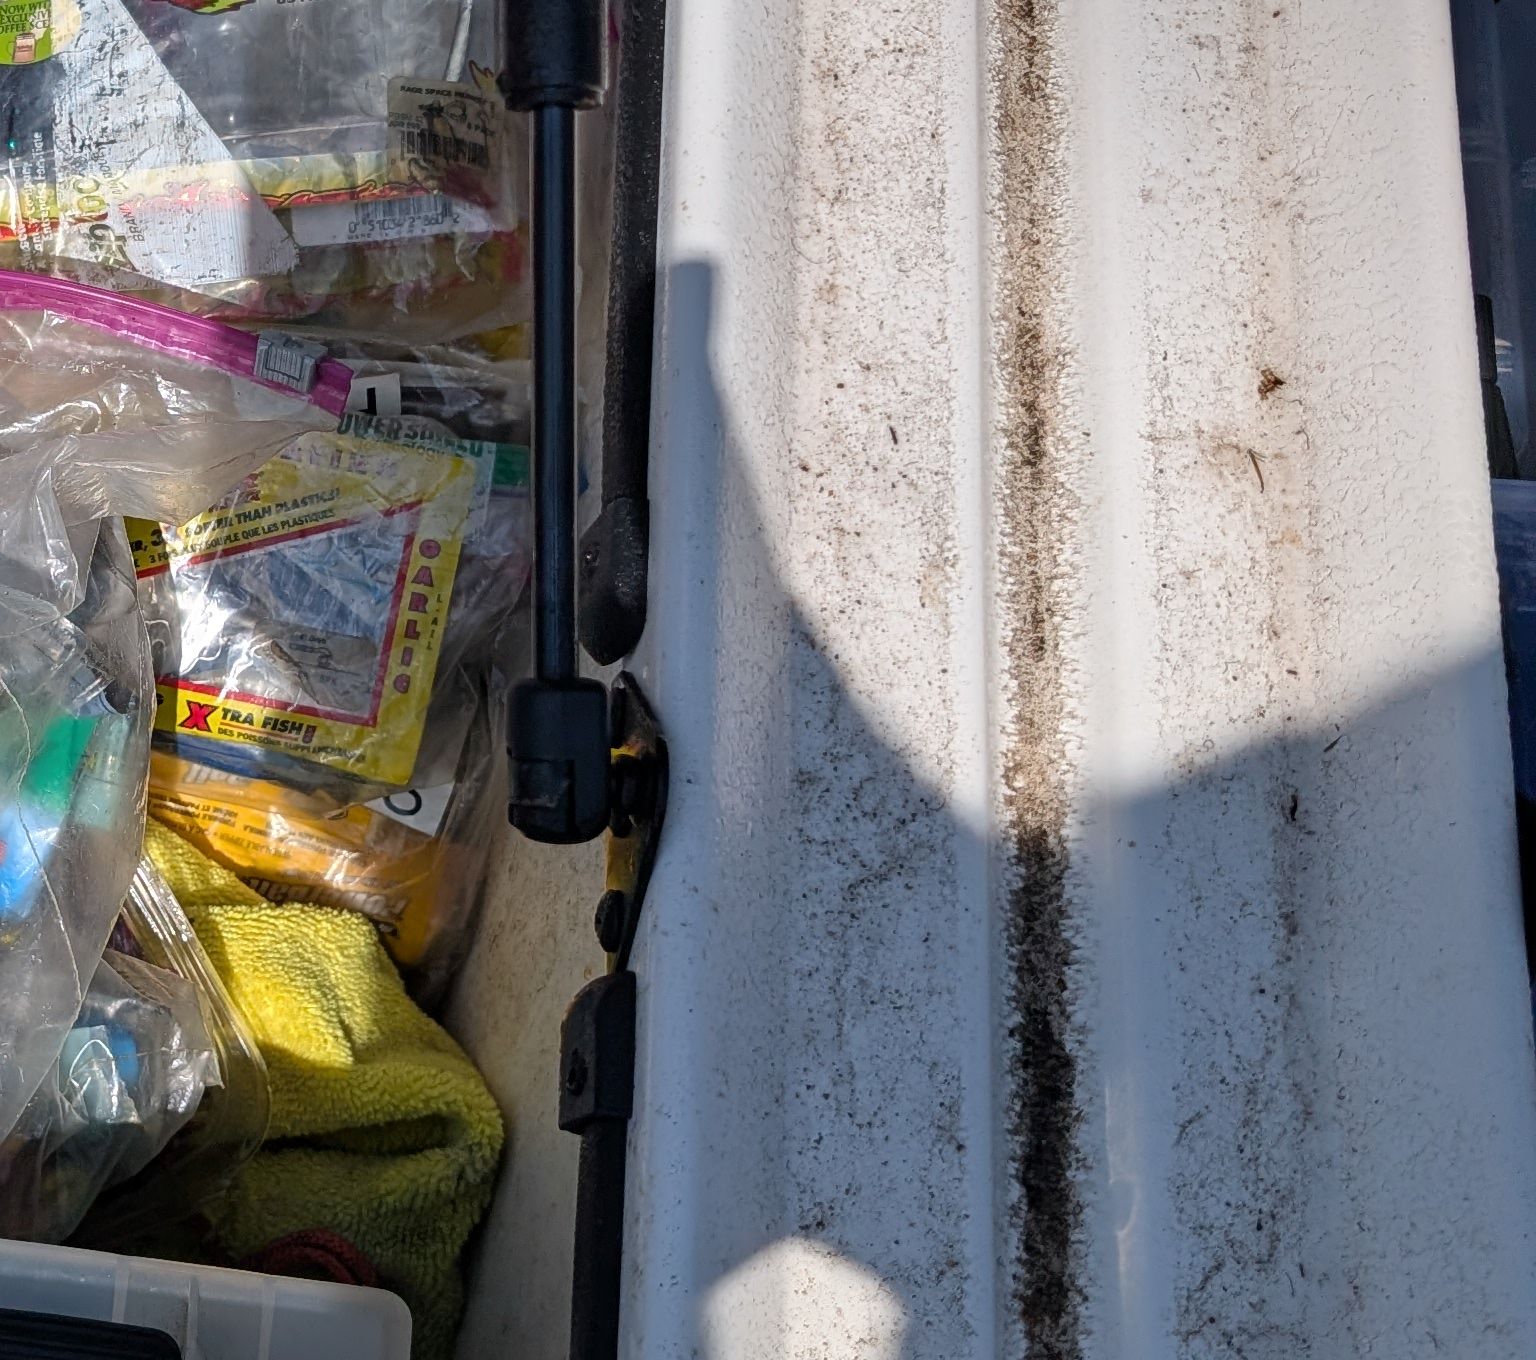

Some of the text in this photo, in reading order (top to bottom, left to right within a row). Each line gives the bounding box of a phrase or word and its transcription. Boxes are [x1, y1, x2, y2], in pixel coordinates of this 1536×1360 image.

[0, 3, 27, 15] NOW
[28, 20, 52, 30] SCE
[241, 526, 261, 539] QUE
[263, 523, 280, 536] LES
[281, 509, 336, 529] PLASTIQUES
[393, 538, 442, 694] GARLIC
[217, 727, 235, 738] DES
